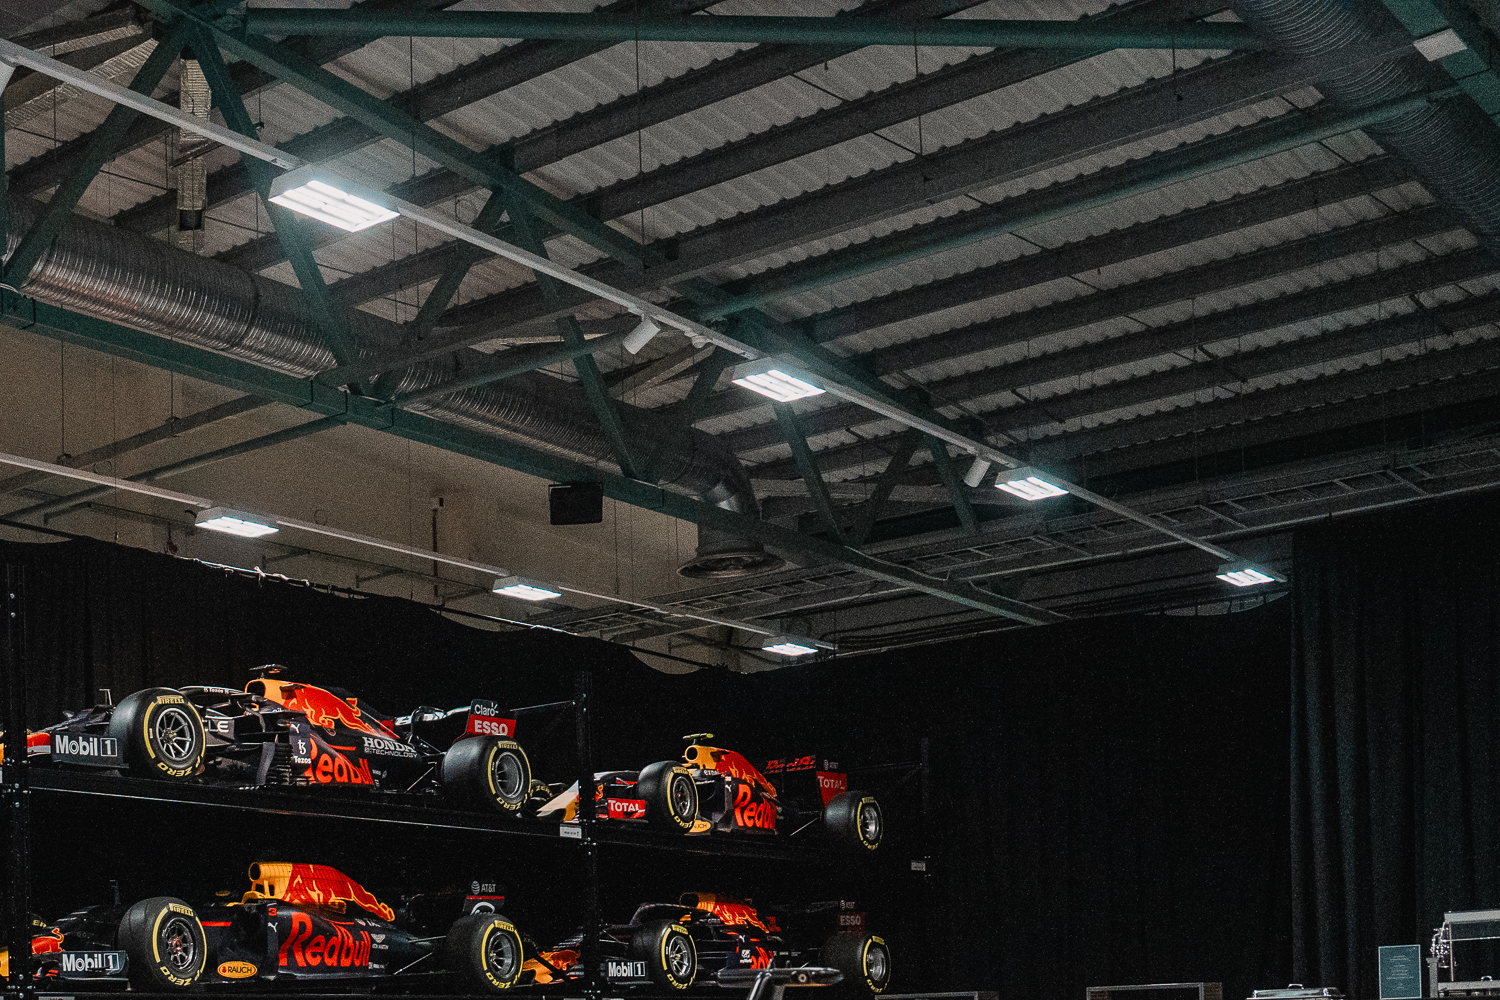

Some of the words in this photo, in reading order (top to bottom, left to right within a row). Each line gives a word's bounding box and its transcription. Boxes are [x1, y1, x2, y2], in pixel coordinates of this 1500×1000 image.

[156, 694, 185, 705] PIRELLI
[474, 719, 509, 737] ESSO
[55, 734, 99, 757] Mobil
[818, 774, 847, 791] TOTAL
[608, 799, 641, 813] TOTAL
[480, 883, 497, 893] AT&T
[839, 914, 862, 926] ESSO
[62, 953, 101, 972] Mobil
[227, 965, 253, 975] RAUCH
[608, 961, 633, 977] Mobil
